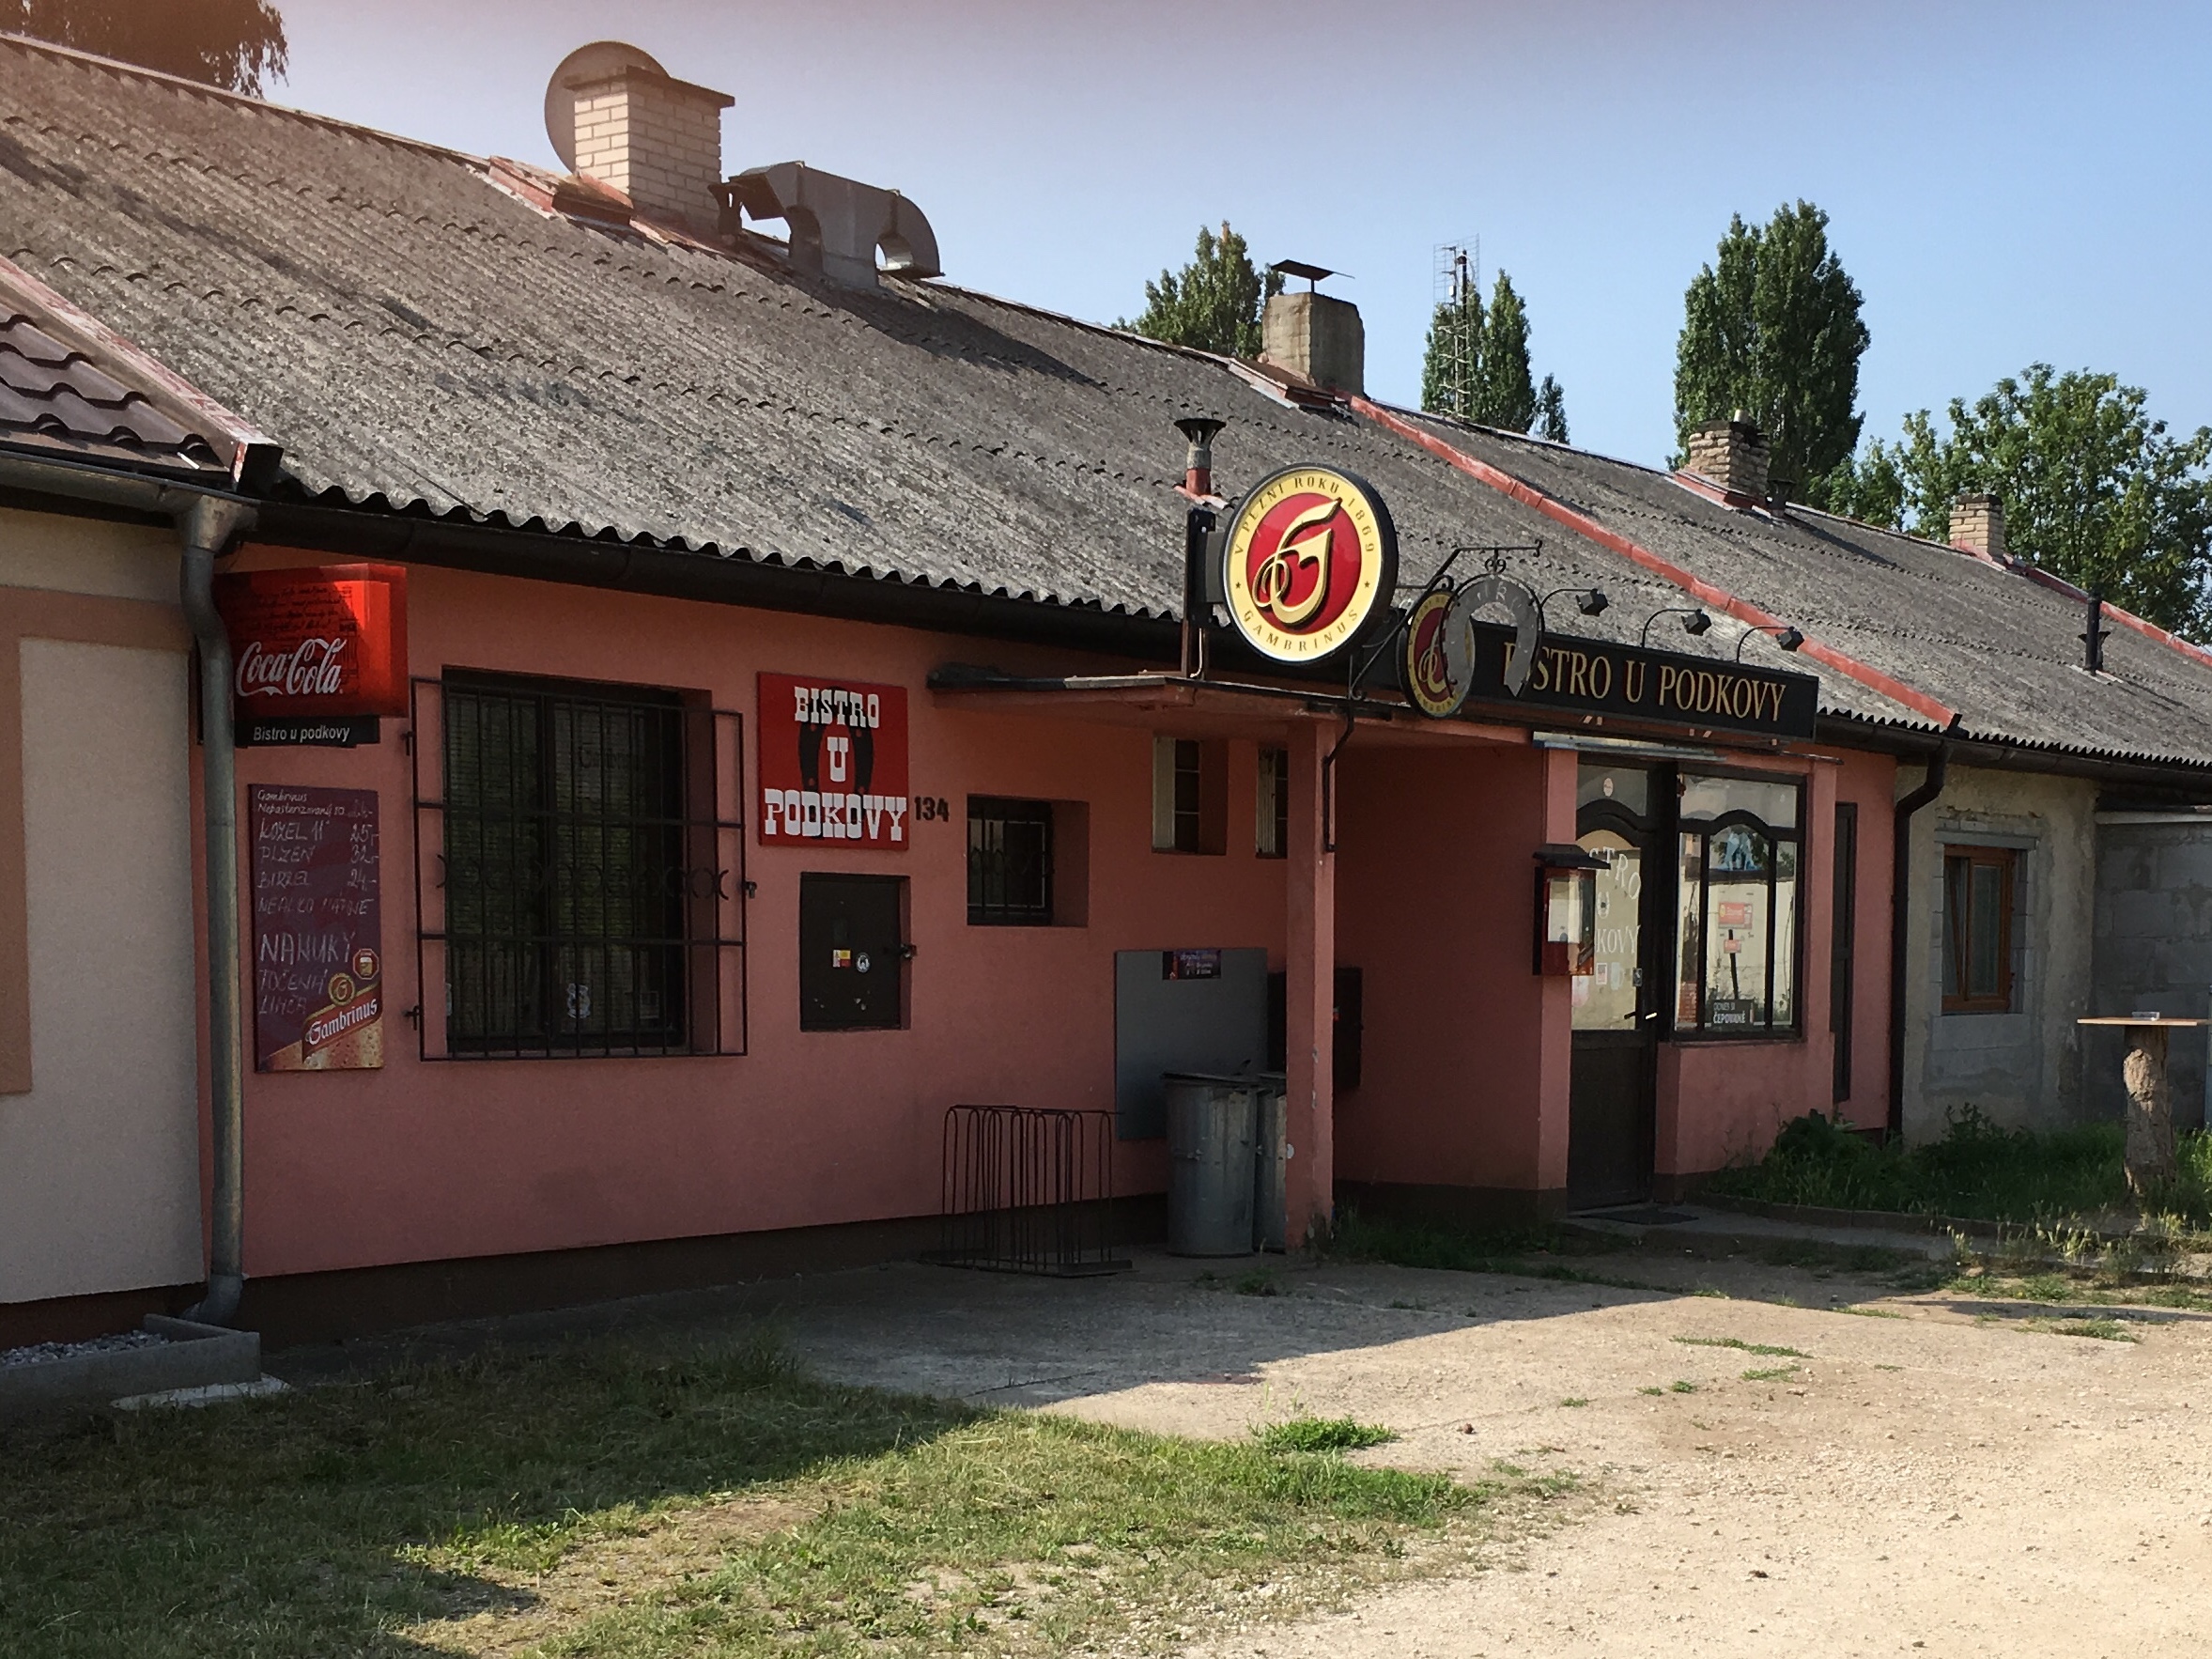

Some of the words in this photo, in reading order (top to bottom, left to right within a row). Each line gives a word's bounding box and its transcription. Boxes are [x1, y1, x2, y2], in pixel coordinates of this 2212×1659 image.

[1293, 475, 1340, 494] ROKU
[1347, 497, 1375, 553] 1869
[1243, 609, 1359, 653] GAMBRINUS
[236, 637, 348, 697] Coca-Cola
[1624, 659, 1647, 704] U
[1659, 664, 1787, 722] PODKOVY
[794, 685, 880, 729] BISTRO
[253, 726, 287, 742] Bistro
[289, 728, 299, 740] u
[299, 724, 351, 744] podkovy
[827, 736, 849, 783] U
[764, 787, 907, 842] PODKOVY
[913, 796, 950, 823] 134
[308, 998, 379, 1046] Gambrinus
